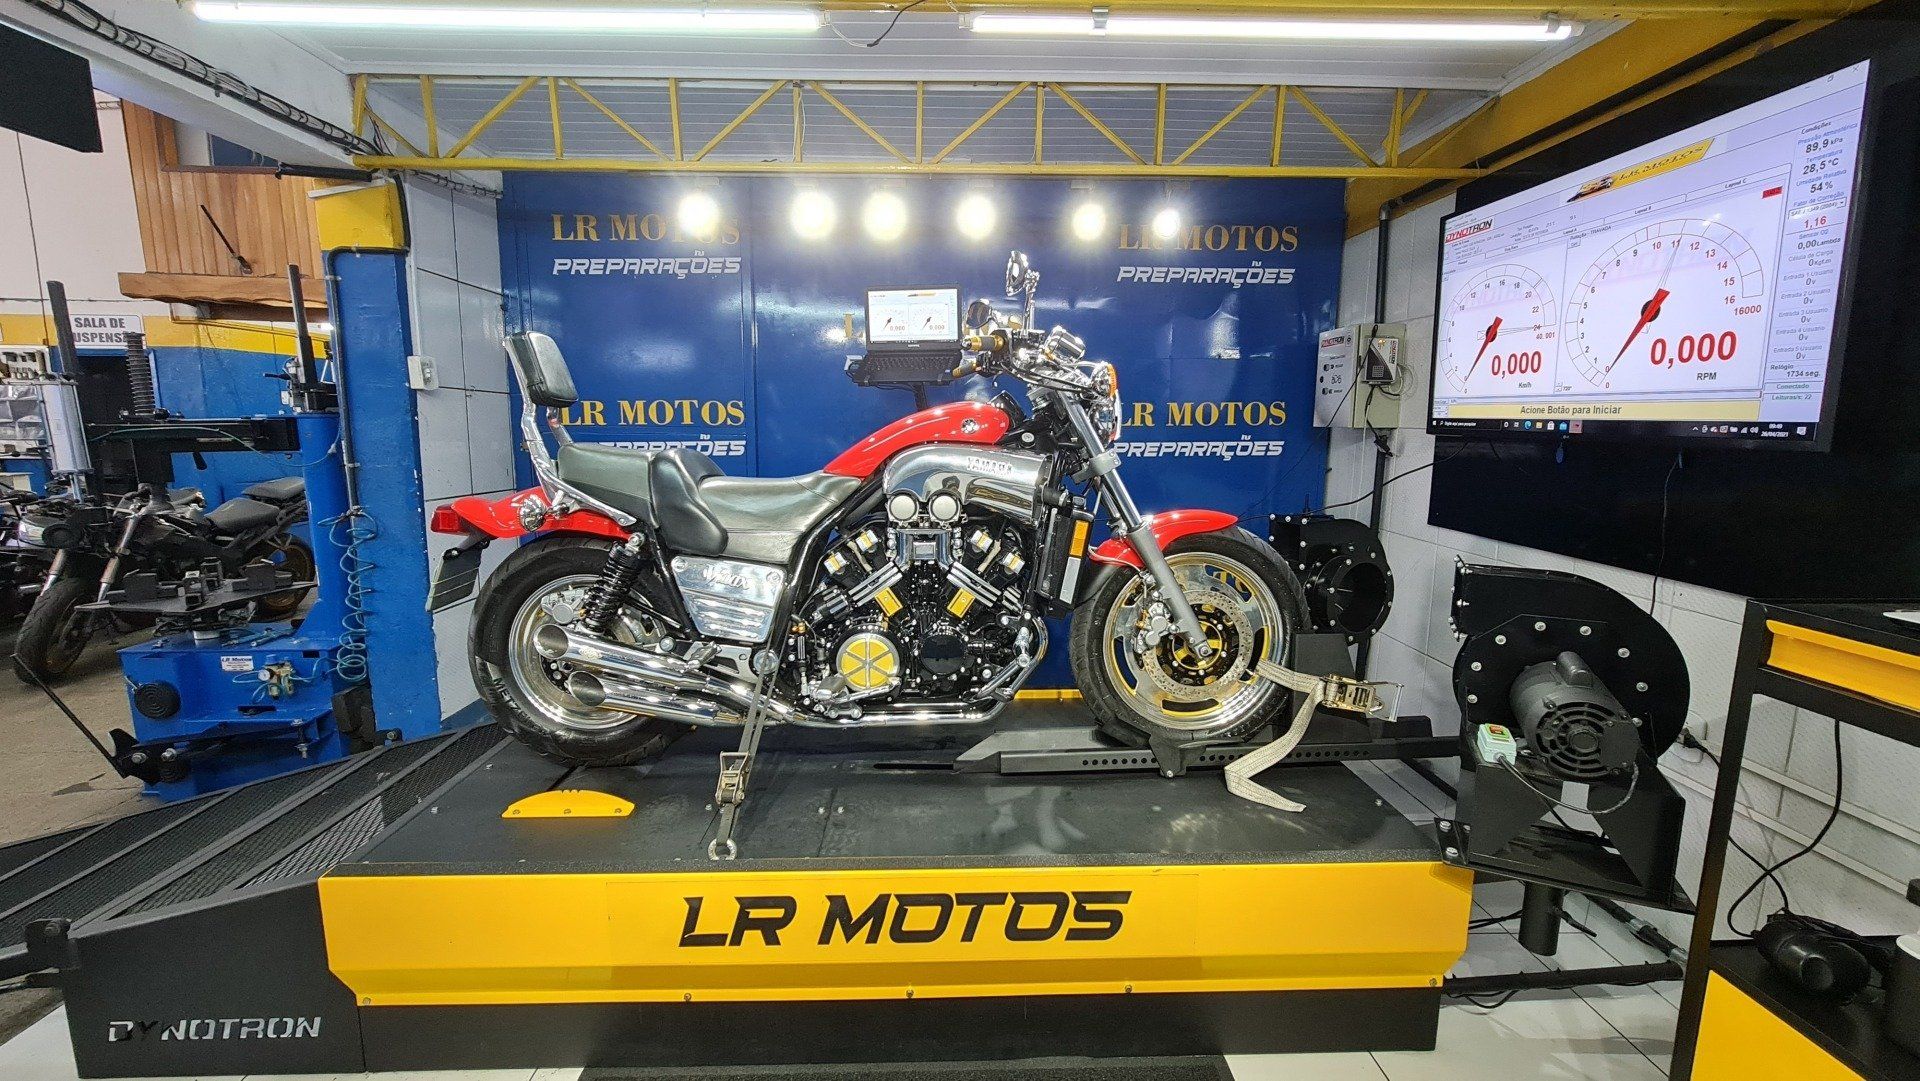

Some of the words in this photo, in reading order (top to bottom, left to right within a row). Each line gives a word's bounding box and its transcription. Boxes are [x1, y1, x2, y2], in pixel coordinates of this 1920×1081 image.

[1806, 138, 1829, 153] 89,9
[1803, 160, 1826, 175] 28,5
[1827, 157, 1839, 167] °C
[1810, 182, 1823, 194] 54
[1824, 181, 1833, 190] %
[551, 214, 600, 242] LR
[1804, 215, 1827, 230] 1,16
[1173, 224, 1298, 252] MOTOS
[1671, 238, 1680, 248] 11
[1652, 241, 1661, 250] 10
[1690, 241, 1700, 251] 12
[1633, 249, 1638, 257] 9
[1705, 249, 1715, 258] 13
[552, 250, 742, 280] PREPARAÇÕES
[1616, 259, 1620, 267] 8
[1717, 260, 1728, 270] 14
[1116, 260, 1296, 289] PREPARAÇÕES
[1602, 271, 1606, 279] 7
[1723, 276, 1735, 287] 15
[1591, 286, 1595, 294] 6
[1724, 295, 1736, 304] 16
[1532, 306, 1540, 314] 22
[1734, 304, 1762, 316] 16000
[74, 317, 107, 328] SALA
[109, 318, 126, 329] DE
[1650, 330, 1737, 370] 0,000
[1491, 350, 1542, 379] 0,000
[1605, 365, 1610, 373] 0
[1770, 363, 1794, 371] Relógio
[1696, 372, 1717, 381] RPM
[1787, 370, 1803, 378] 1734
[561, 399, 607, 426] LR
[617, 399, 745, 427] MOTOS
[1165, 401, 1286, 427] MOTOS
[1520, 405, 1545, 414] Acione
[1547, 405, 1570, 414] Botão
[1572, 406, 1591, 416] para
[1592, 405, 1622, 414] Iniciar
[1112, 434, 1285, 461] PREPARAÇÕES
[678, 895, 797, 948] LR
[817, 890, 1133, 945] MOTOS
[108, 1016, 322, 1042] DYNOTRON
